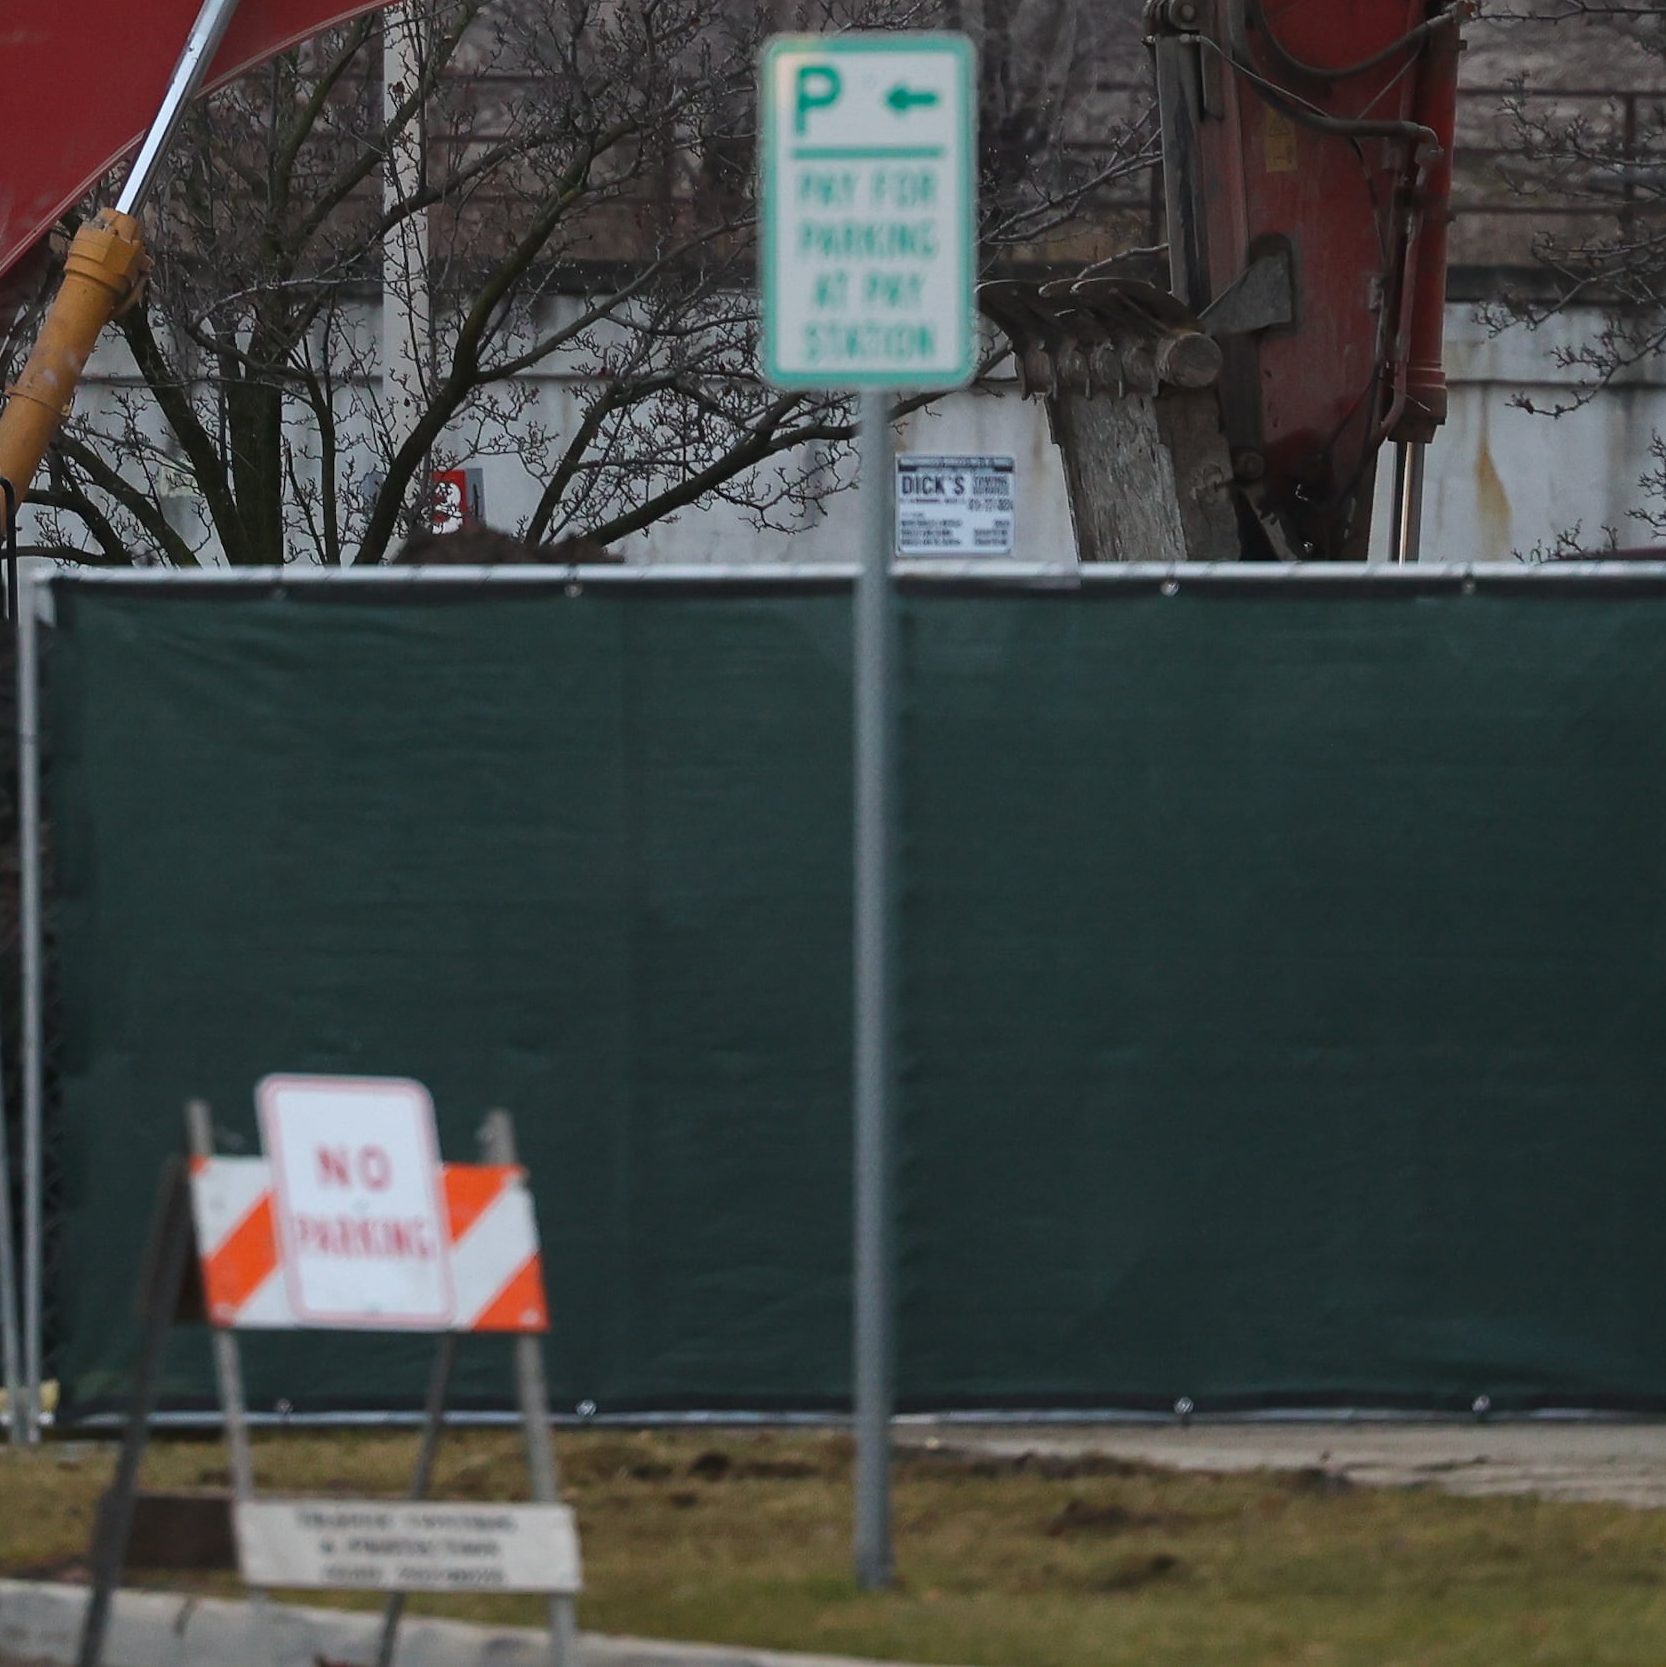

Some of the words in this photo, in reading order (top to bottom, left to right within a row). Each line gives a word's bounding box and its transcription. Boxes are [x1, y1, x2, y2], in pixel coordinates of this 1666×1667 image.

[795, 65, 842, 136] P
[798, 170, 856, 207] PAY
[871, 169, 937, 206] FOR
[798, 220, 939, 259] PARKING
[814, 271, 850, 309] AT
[863, 270, 927, 308] PAY
[802, 322, 936, 361] STATION
[901, 475, 965, 495] DICK'S
[314, 1142, 394, 1192] NO
[295, 1214, 437, 1261] PARKING
